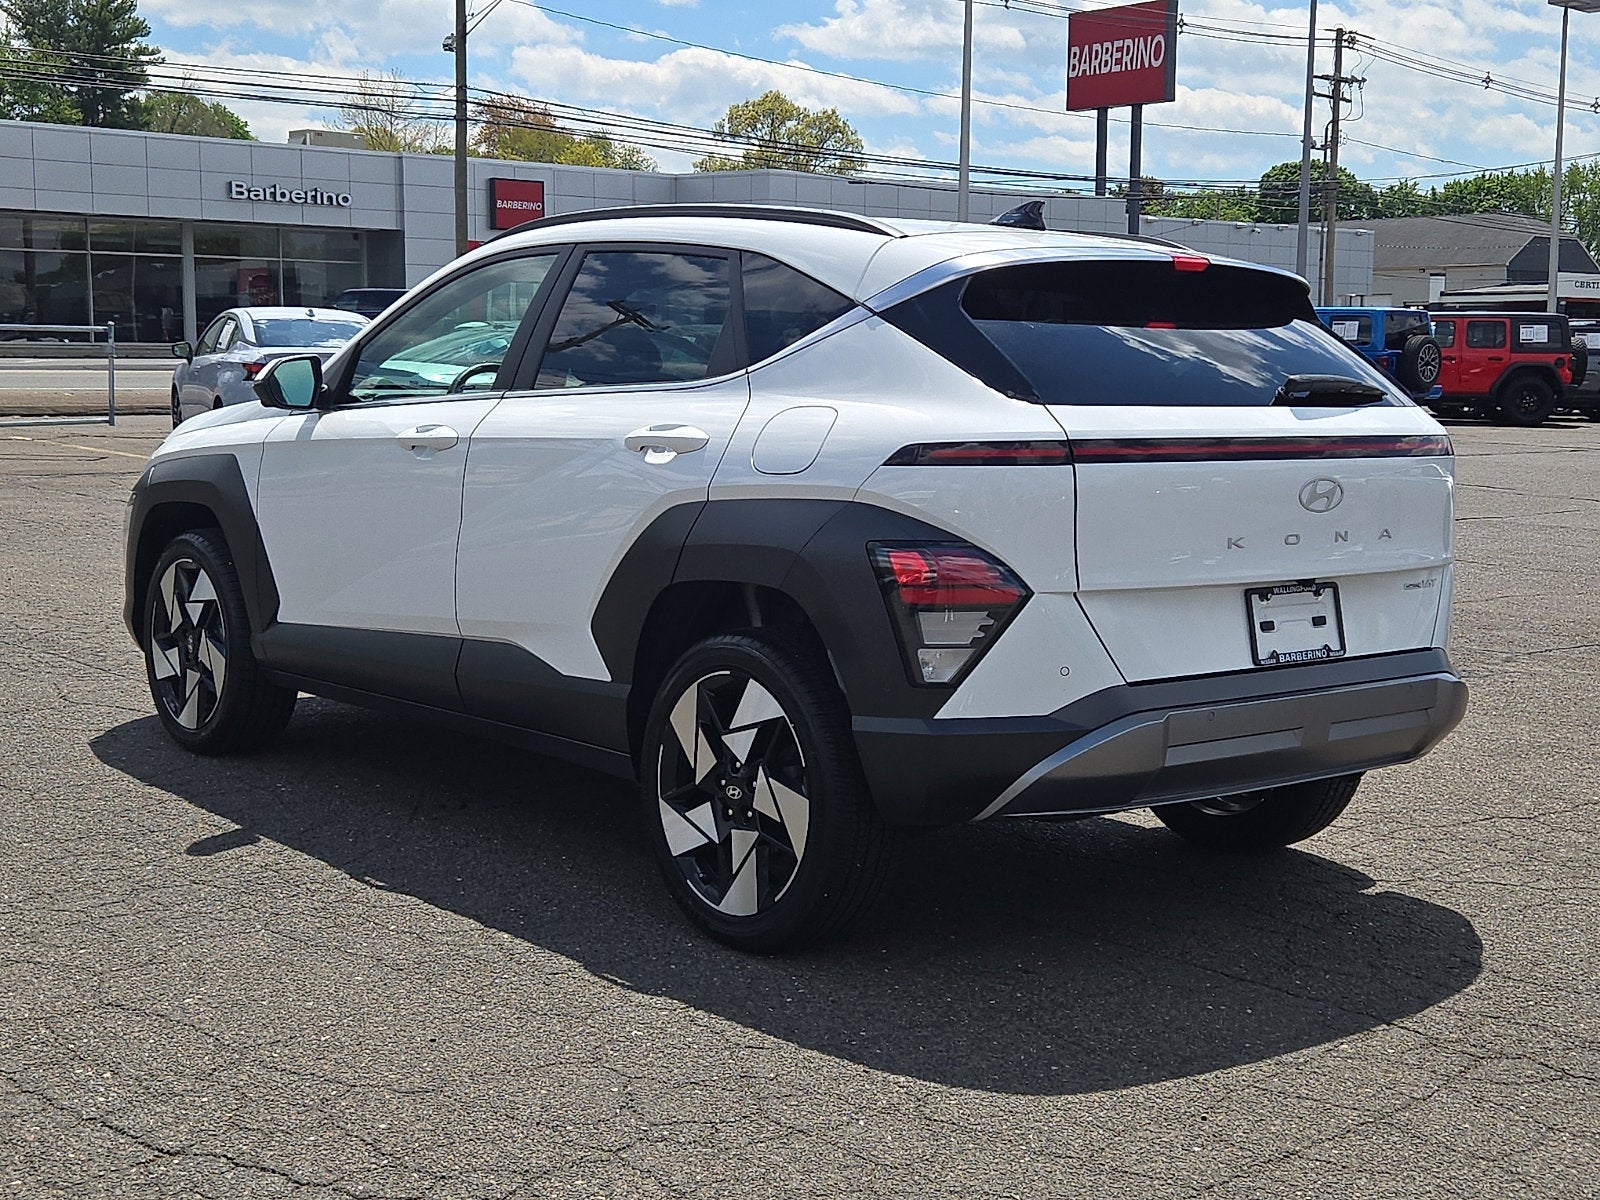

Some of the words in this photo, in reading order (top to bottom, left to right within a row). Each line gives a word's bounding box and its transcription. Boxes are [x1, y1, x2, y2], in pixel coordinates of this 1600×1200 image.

[1068, 34, 1165, 78] BARBERINO
[229, 180, 353, 207] Barberino
[496, 199, 543, 211] BARBERINO
[1226, 528, 1392, 550] KONA
[1279, 649, 1328, 663] BARBERINO
